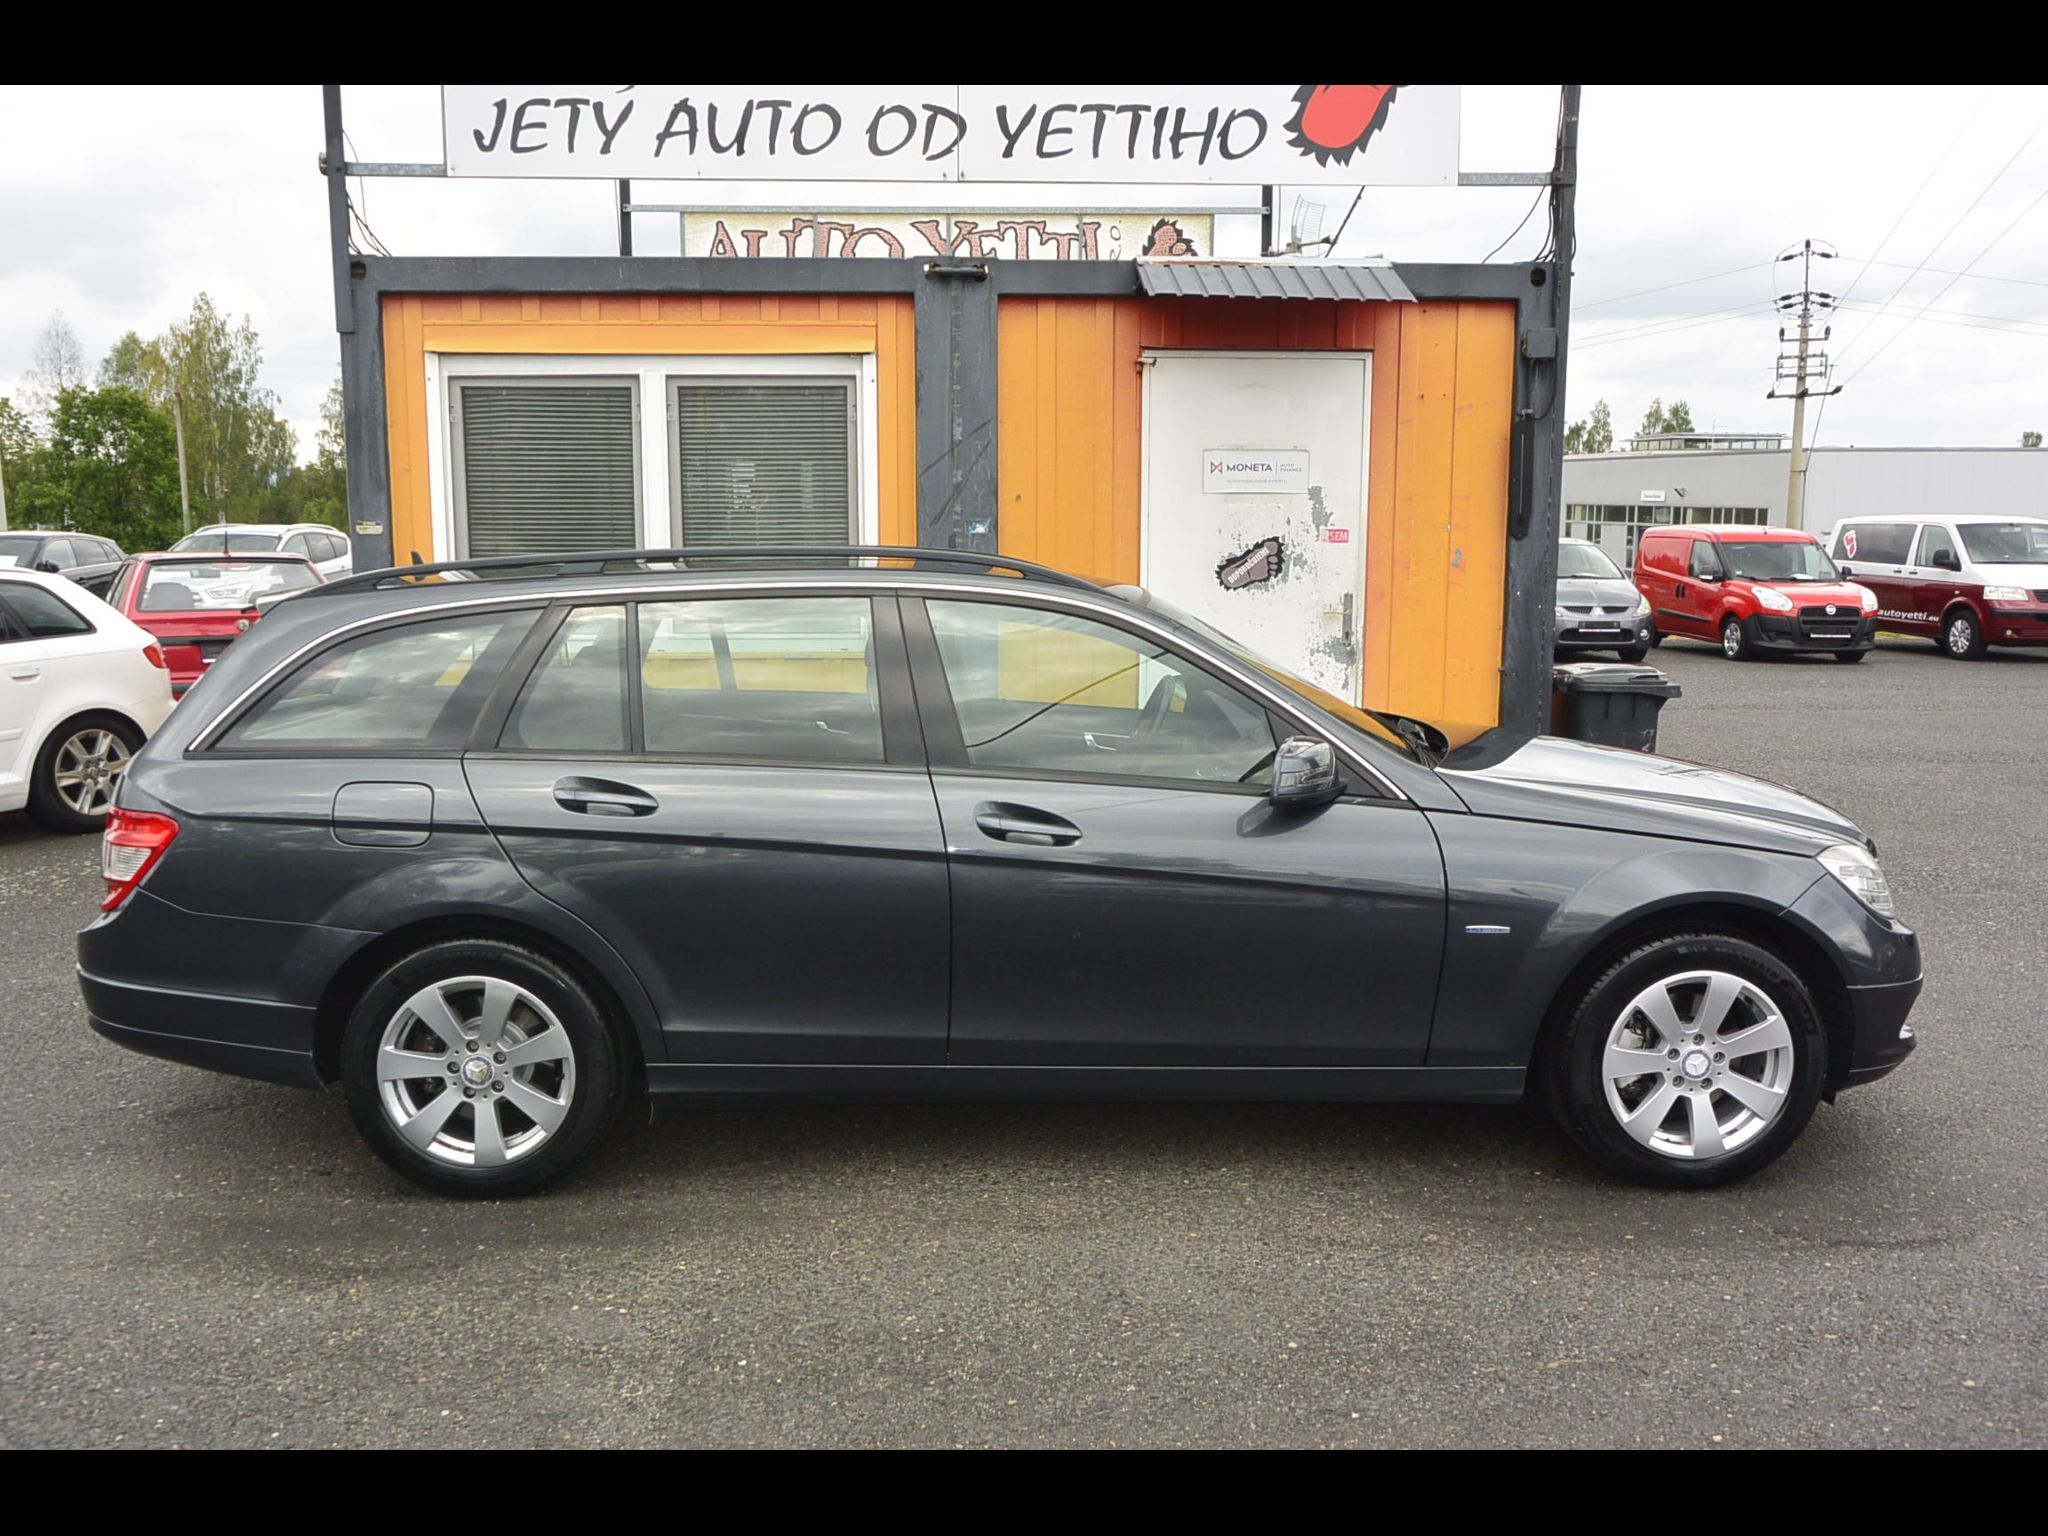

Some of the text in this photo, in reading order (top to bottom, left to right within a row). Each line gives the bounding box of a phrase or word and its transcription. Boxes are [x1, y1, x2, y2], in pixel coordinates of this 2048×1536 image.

[473, 85, 1268, 165] JETÝ AUTO OD YETTIHO
[1226, 463, 1273, 472] MONETA
[1330, 531, 1348, 541] SEM
